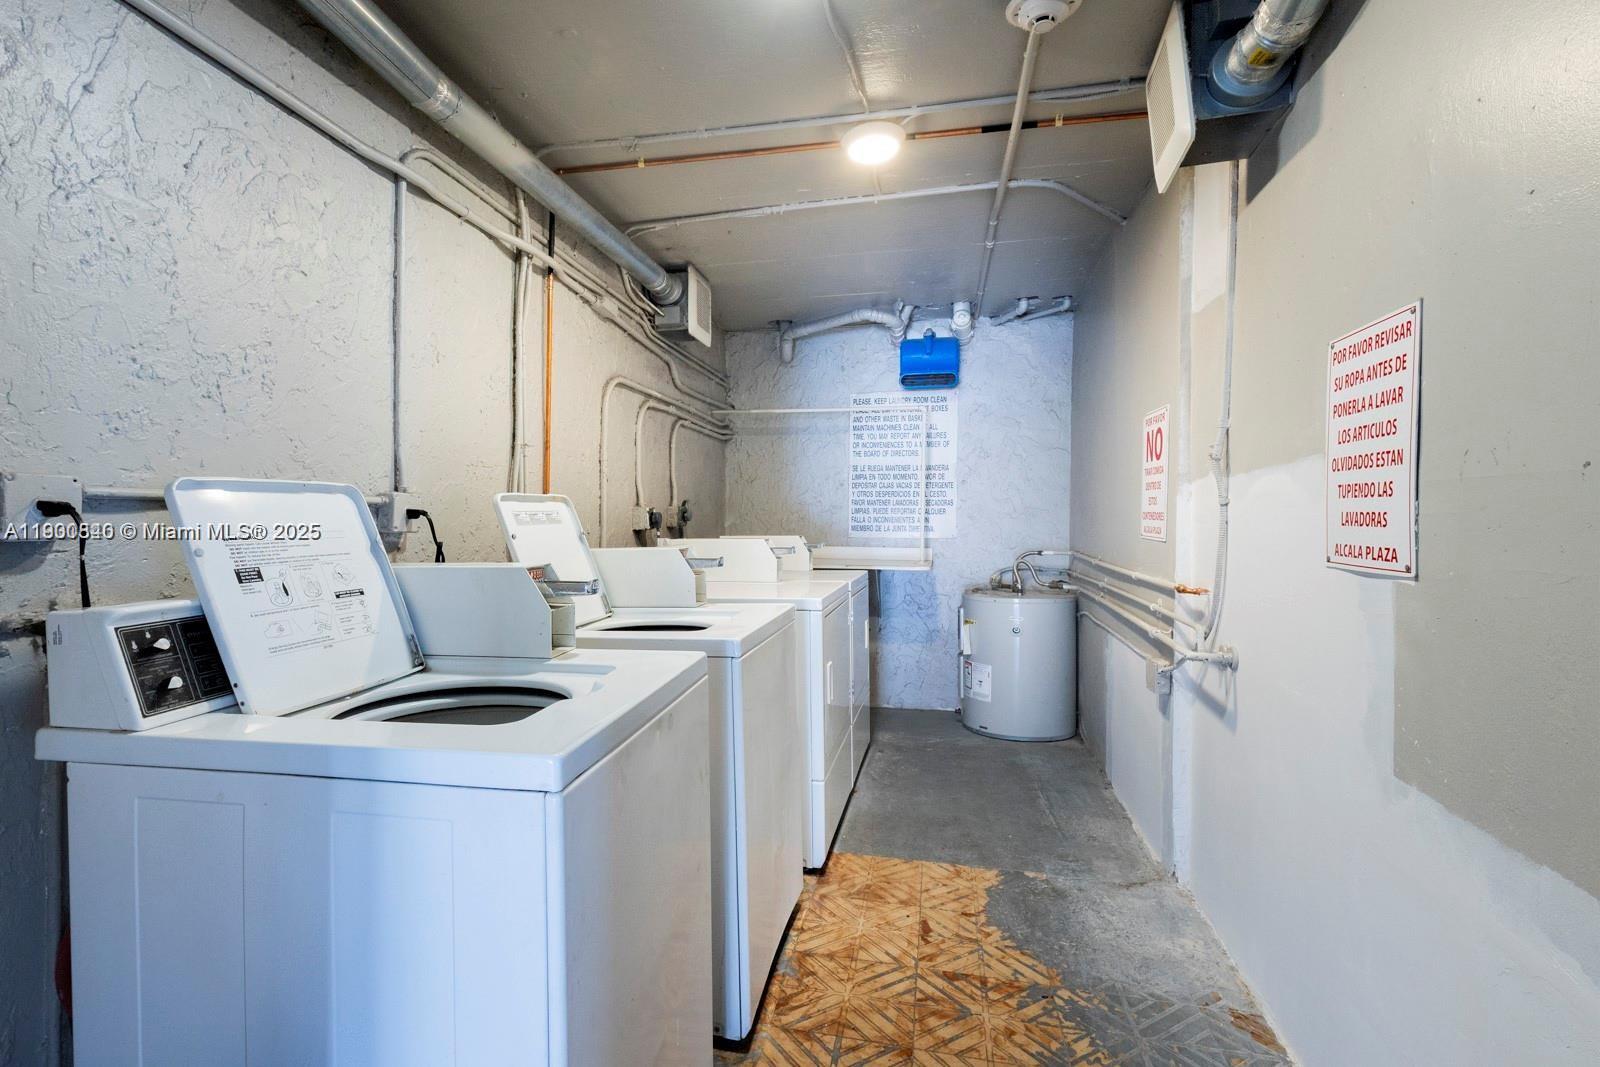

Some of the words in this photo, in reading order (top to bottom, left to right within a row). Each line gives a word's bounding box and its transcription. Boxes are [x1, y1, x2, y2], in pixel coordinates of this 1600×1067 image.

[1333, 348, 1347, 366] POR
[1348, 337, 1373, 360] FAVOR
[1374, 320, 1412, 350] REVISAR
[1334, 376, 1344, 392] SU
[1345, 369, 1365, 389] ROPA
[1366, 358, 1393, 382] ANTES
[1395, 354, 1408, 373] DE
[913, 396, 928, 404] ROOM
[1333, 397, 1365, 419] PONERLA
[1368, 395, 1374, 411] A
[1376, 386, 1404, 409] LAVAR
[1338, 428, 1351, 445] LOS
[1352, 418, 1398, 442] ARTICULOS
[1146, 427, 1163, 462] NO
[1332, 452, 1374, 472] OLVIDADOS
[1376, 448, 1404, 468] ESTAN
[1338, 482, 1376, 498] TUPIENDO
[1378, 481, 1394, 497] LAS
[1341, 512, 1388, 528] LAVADORAS
[1334, 544, 1362, 559] ALCALA
[1366, 546, 1398, 563] PLAZA
